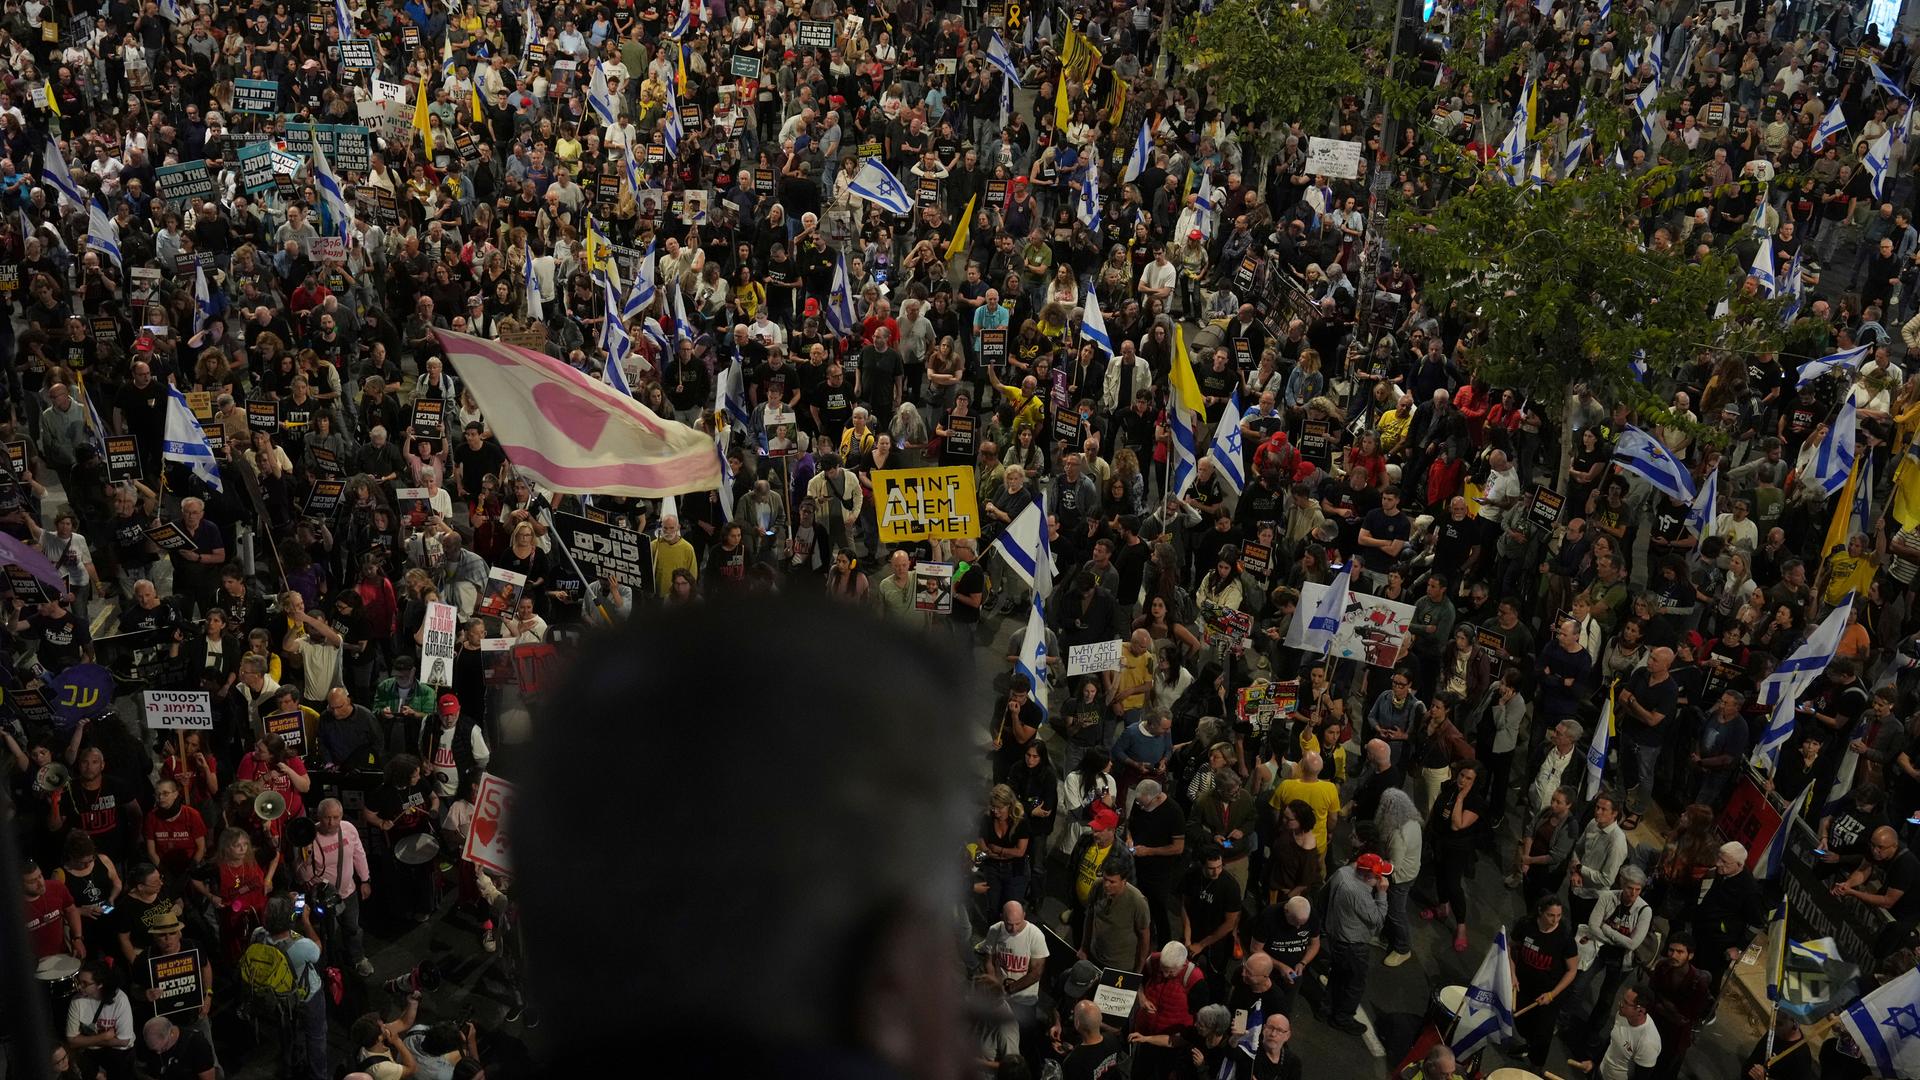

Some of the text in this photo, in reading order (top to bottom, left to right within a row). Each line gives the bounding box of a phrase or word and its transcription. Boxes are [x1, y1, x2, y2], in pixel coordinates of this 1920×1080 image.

[250, 89, 260, 98] דם
[288, 131, 309, 142] END
[339, 147, 366, 155] BLOOD
[337, 155, 356, 163] WILL
[337, 162, 368, 171] SPILLED?
[160, 168, 208, 186] END THE
[163, 180, 212, 198] BLOODSHED
[7, 264, 18, 273] MY
[0, 273, 18, 281] EOPLE
[1793, 412, 1813, 422] FCK
[888, 498, 952, 514] THEM
[610, 528, 637, 544] את
[573, 531, 640, 562] כולם
[570, 548, 642, 576] בפעימה
[430, 616, 437, 629] TO
[428, 630, 439, 643] FOR
[425, 642, 453, 659] QATARGATE
[1073, 642, 1116, 655] WHY ARE
[1070, 651, 1120, 664] THEY STILL
[1080, 661, 1114, 672] THERE?
[152, 693, 208, 703] דיפסטייט
[162, 716, 211, 727] קטארים
[159, 975, 196, 989] מסרבים
